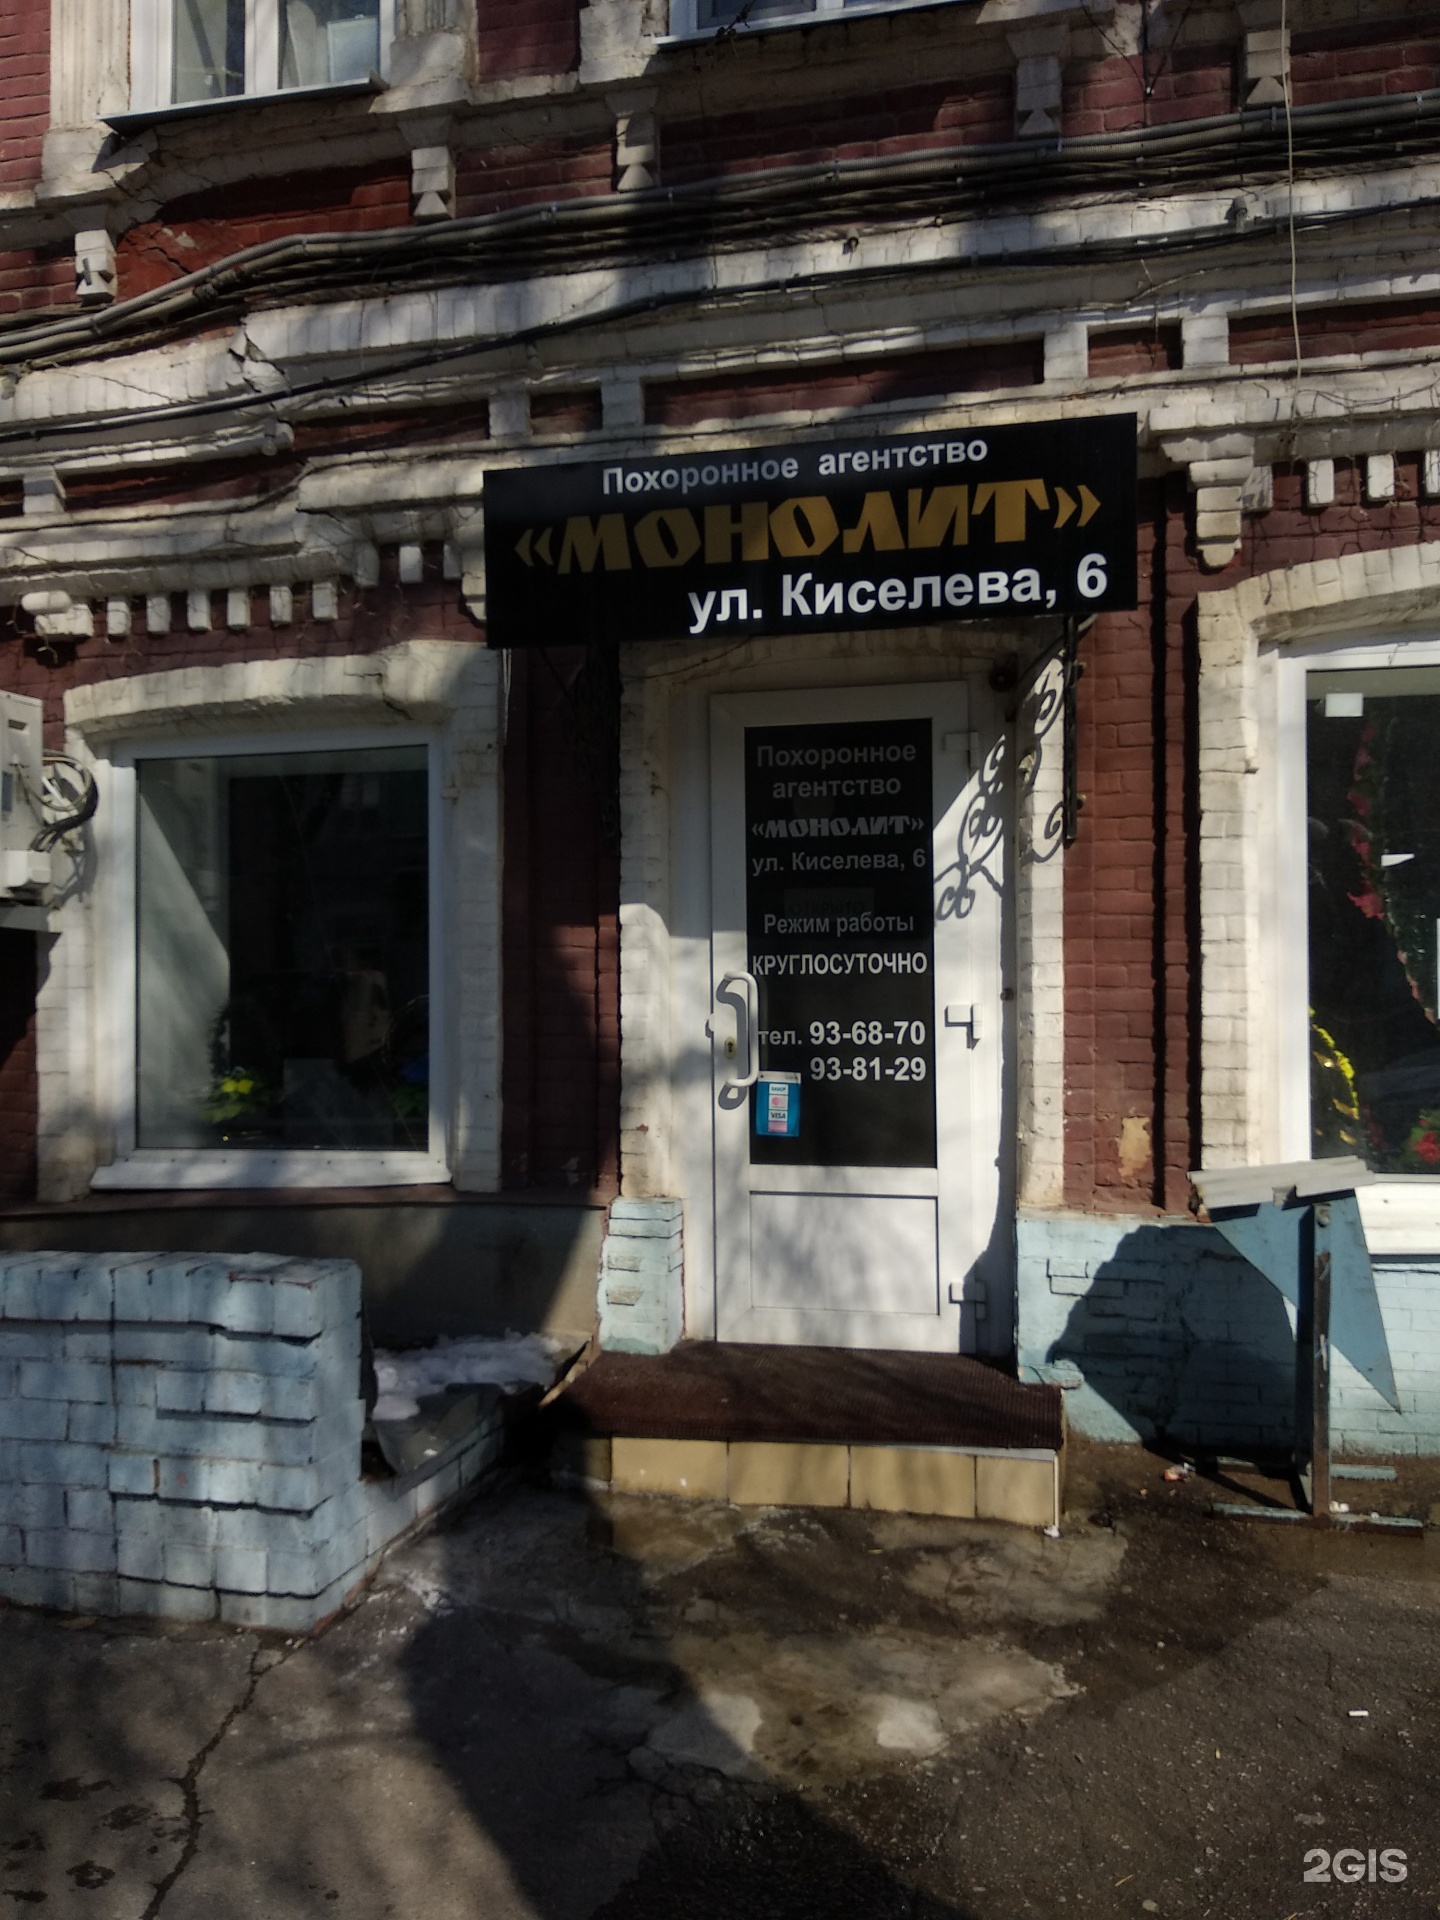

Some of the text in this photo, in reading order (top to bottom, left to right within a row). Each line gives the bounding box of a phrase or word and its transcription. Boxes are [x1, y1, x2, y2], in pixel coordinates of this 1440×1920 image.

[601, 438, 989, 496] Похоронное агентство
[514, 478, 1101, 575] «МОНОЛИТ»
[689, 552, 1109, 633] ул. Киселева, 6
[757, 743, 917, 770] Похоронное
[772, 777, 902, 799] агентство
[752, 814, 925, 839] «МОНОЛИТ»
[752, 848, 926, 877] ул. Киселева, 6
[763, 911, 914, 938] Режим работы
[752, 951, 928, 976] КРУГЛОСУТОЧНО
[758, 1020, 926, 1046] тел. 93-68-70
[810, 1056, 927, 1082] 93-81-29
